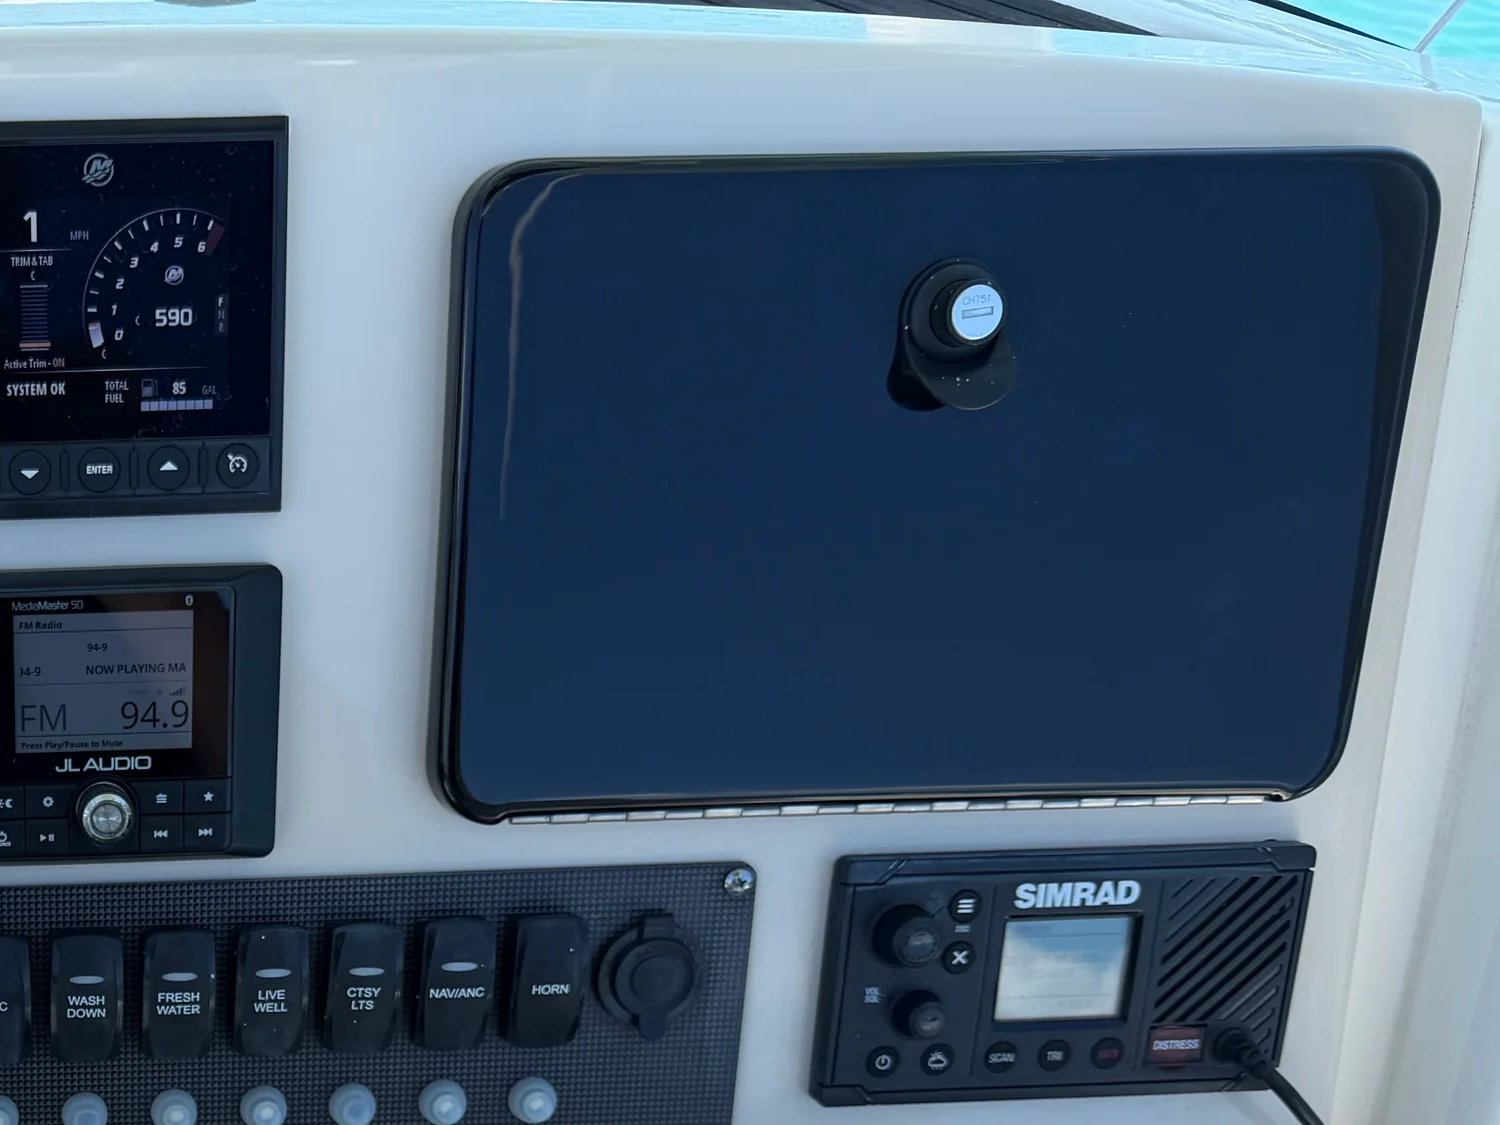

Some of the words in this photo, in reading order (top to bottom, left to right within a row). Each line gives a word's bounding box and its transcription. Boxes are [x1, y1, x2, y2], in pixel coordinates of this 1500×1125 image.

[23, 211, 38, 243] 1
[70, 230, 89, 241] MPH
[150, 241, 159, 253] 4
[174, 236, 184, 248] 5
[197, 241, 206, 253] 6
[11, 256, 31, 267] TRIM
[31, 257, 38, 266] &
[38, 256, 54, 266] TAB
[129, 257, 139, 268] 3
[115, 278, 125, 290] 2
[962, 293, 992, 306] CH751
[111, 304, 118, 316] 1
[155, 308, 193, 327] 590
[114, 329, 124, 341] 0
[4, 360, 27, 370] Active
[28, 359, 47, 369] Trim
[52, 358, 66, 368] ON
[6, 382, 47, 397] SYSTEM
[50, 382, 66, 396] OK
[105, 380, 129, 391] TOTAL
[172, 381, 187, 396] 85
[202, 385, 217, 395] GAL
[105, 393, 125, 404] FUEL
[86, 464, 114, 475] ENTER
[12, 601, 69, 612] MediaMaster
[19, 621, 34, 630] FM
[35, 620, 63, 630] Radio
[87, 643, 108, 653] 94-9
[86, 664, 115, 676] NOW
[117, 663, 165, 675] PLAYING
[168, 662, 187, 673] MA
[20, 703, 67, 733] FM
[121, 699, 189, 730] 94.9
[21, 742, 43, 750] Press
[45, 741, 89, 751] Play/Pause
[91, 740, 100, 748] to
[101, 739, 124, 748] Mute
[55, 758, 81, 773] JL
[83, 755, 152, 772] AUDIO
[1013, 879, 1142, 910] SIMRAD
[257, 989, 286, 1000] LIVE
[346, 987, 381, 999] CTSY
[429, 986, 485, 999] NAV/ANC
[531, 983, 570, 995] HORN
[67, 995, 106, 1006] WASH
[157, 991, 200, 1003] FRESH
[156, 1004, 201, 1015] WATER
[253, 1002, 288, 1013] WELL
[351, 1000, 374, 1011] LTS
[66, 1008, 106, 1019] DOWN
[1152, 1039, 1201, 1051] DISTRESS
[988, 1053, 1016, 1064] SCAN
